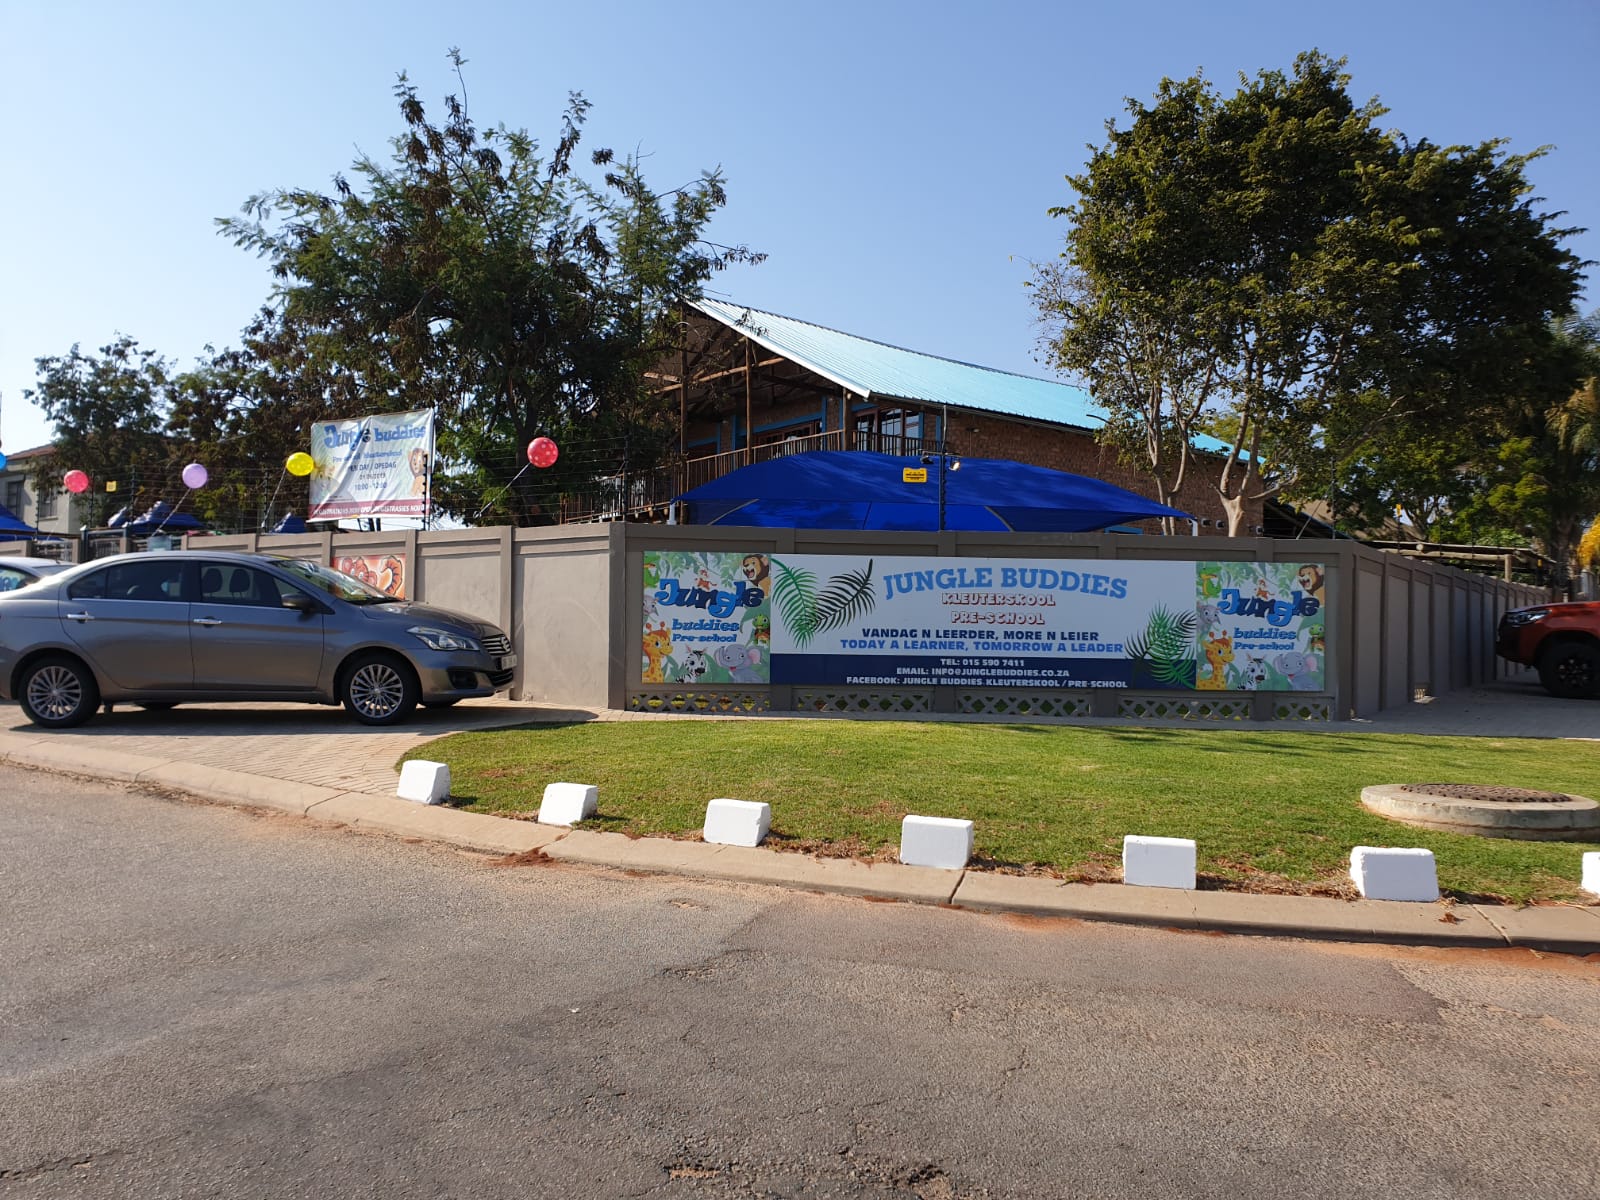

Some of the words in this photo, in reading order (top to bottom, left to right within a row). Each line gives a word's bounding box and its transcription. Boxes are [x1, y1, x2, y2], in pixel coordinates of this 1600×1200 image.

[323, 422, 371, 451] Junge
[374, 423, 427, 442] buddies
[883, 567, 993, 600] JUNGLE
[1000, 567, 1128, 600] BUDDIES
[654, 578, 765, 618] Jungle
[941, 592, 1056, 606] KLEUTERSKOOL
[1217, 588, 1321, 627] Jungle
[951, 610, 1046, 625] PRE-SCHOOL
[672, 618, 740, 631] buddies
[671, 633, 738, 642] Pre-school
[862, 628, 918, 638] VANDAG
[921, 629, 931, 639] N
[935, 629, 999, 640] LEERDER,
[1003, 630, 1042, 640] MORE
[1046, 631, 1056, 641] N
[1060, 631, 1099, 641] LEIER
[1233, 627, 1297, 639] buddies
[840, 639, 885, 649] TODAY
[890, 640, 899, 650] A
[903, 640, 969, 651] LEARNER,
[973, 641, 1053, 652] TOMORROW
[1057, 643, 1067, 652] A
[1071, 643, 1123, 653] LEADER
[1233, 642, 1295, 651] Pre-school
[940, 658, 961, 666] TEL:
[982, 659, 1000, 667] 590
[896, 667, 929, 675] EMAIL:
[931, 668, 1070, 677] INFO@JUNGLEBUDDIES.CO.ZA
[846, 676, 901, 684] FACEBOOK:
[902, 677, 938, 685] JUNGLE
[985, 679, 1060, 687] KLEUTERSKOOL
[1067, 680, 1128, 688] PRE-SCHOOL
